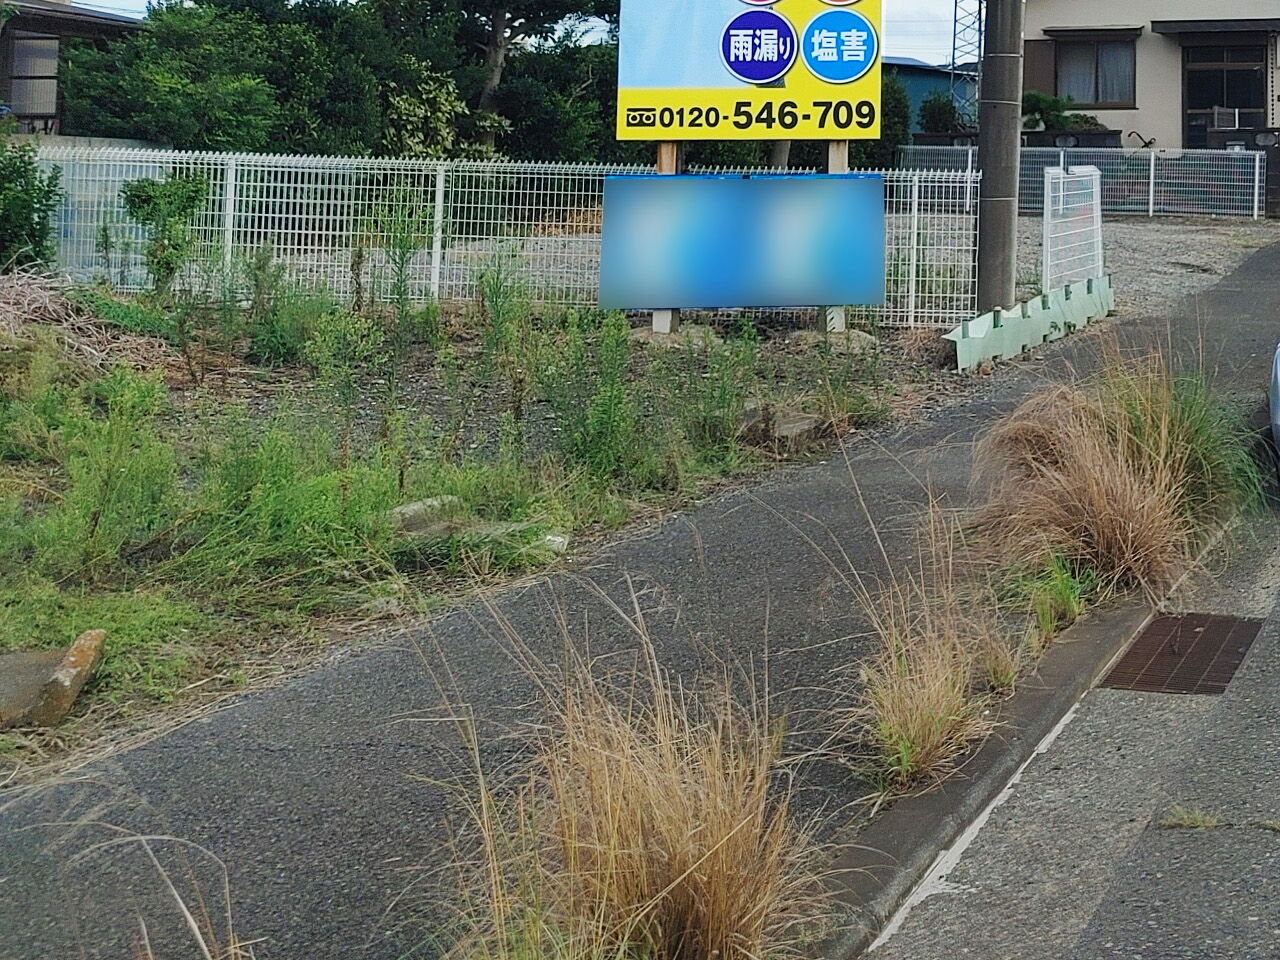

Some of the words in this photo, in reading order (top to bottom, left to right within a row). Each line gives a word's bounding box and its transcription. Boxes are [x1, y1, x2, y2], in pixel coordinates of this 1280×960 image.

[729, 28, 791, 63] 雨漏り
[810, 28, 868, 63] 塩害
[659, 100, 876, 129] 0120-546-709
